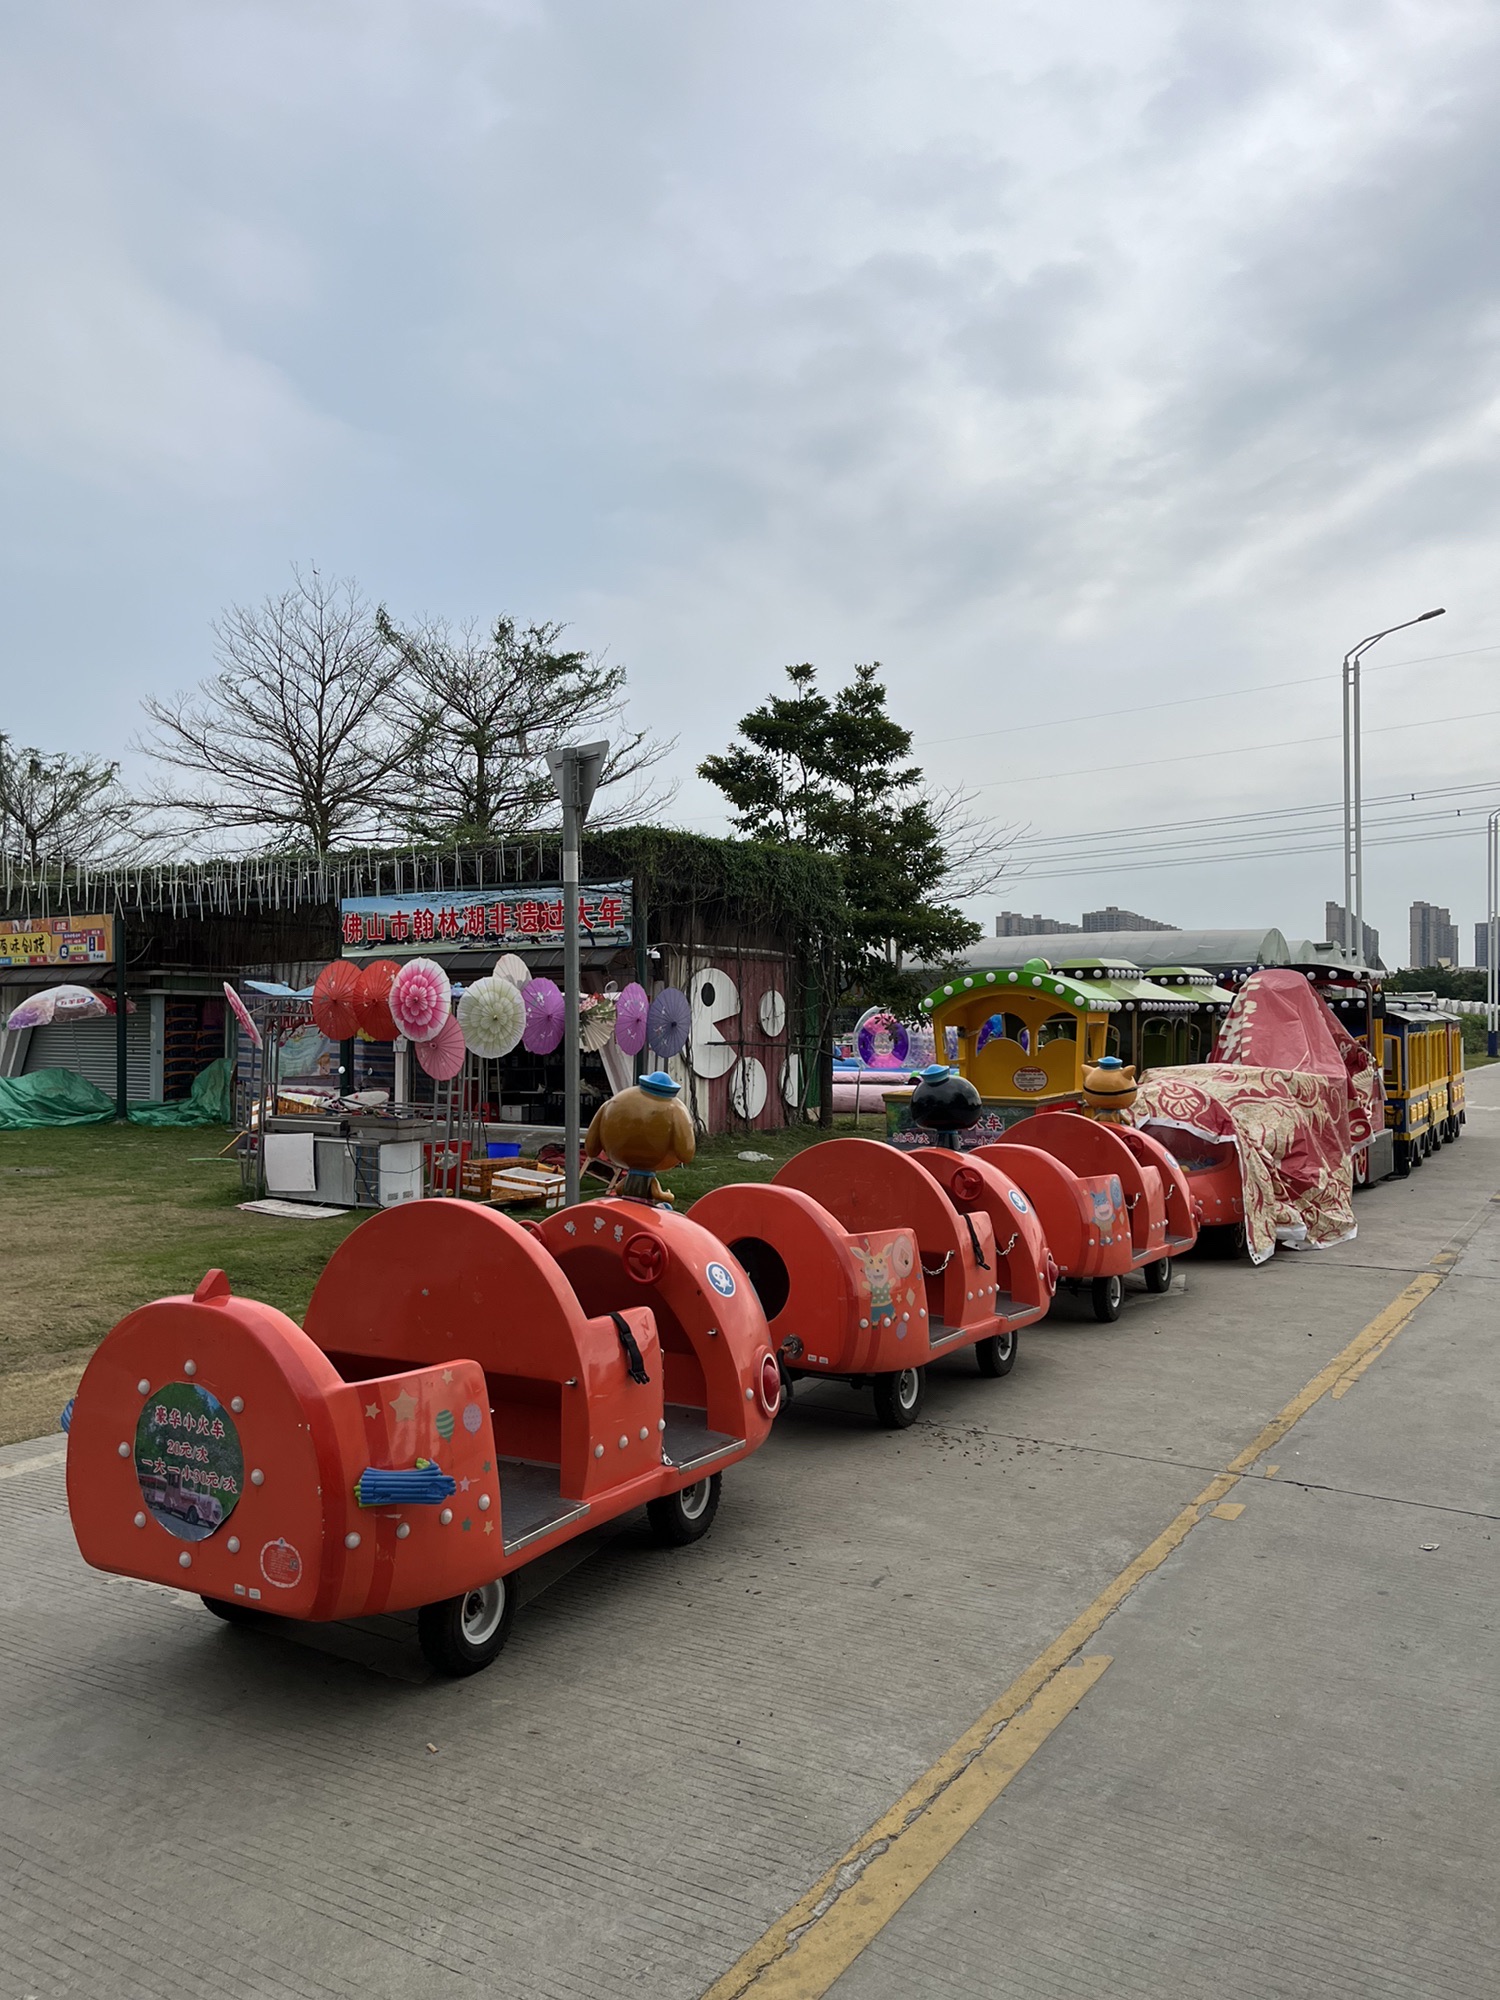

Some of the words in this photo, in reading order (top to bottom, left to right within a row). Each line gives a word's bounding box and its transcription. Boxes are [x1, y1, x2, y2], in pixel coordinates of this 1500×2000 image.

[342, 896, 625, 943] 佛山市翰林湖非遗过大年
[155, 1405, 225, 1439] 豪华小火车
[167, 1439, 209, 1463] 20元/次
[142, 1457, 238, 1493] 一大一小30元/次
